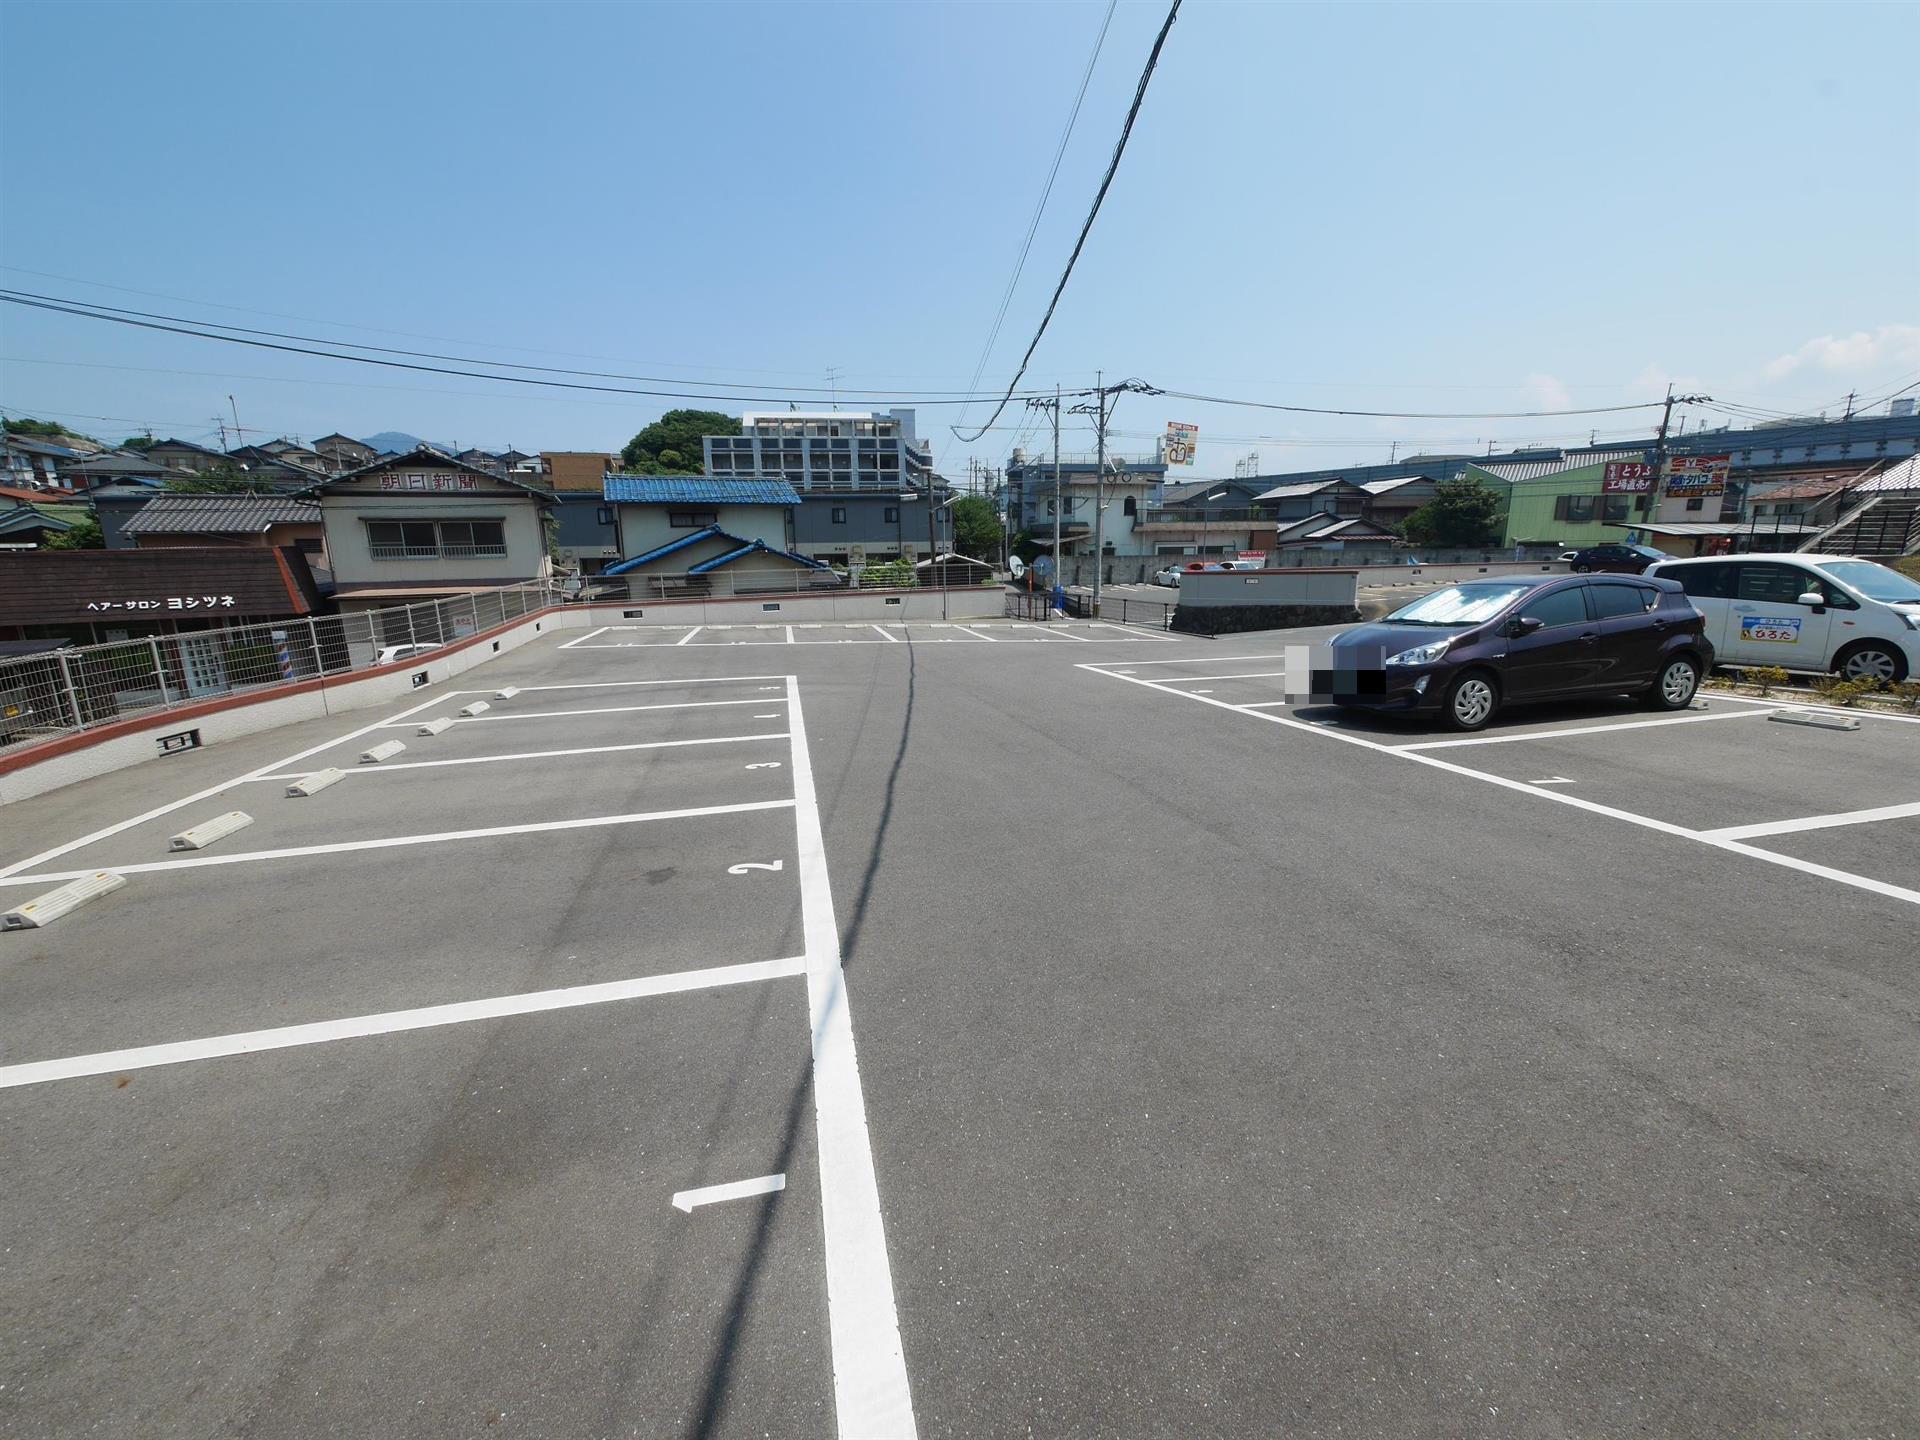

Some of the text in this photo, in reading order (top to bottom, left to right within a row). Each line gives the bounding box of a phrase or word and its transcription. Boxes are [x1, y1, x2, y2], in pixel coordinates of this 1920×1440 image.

[381, 473, 478, 490] 朝日新聞
[87, 595, 236, 611] ヘアーサロン ヨシツネ
[1755, 630, 1791, 640] ひろた
[745, 761, 782, 770] 3
[727, 859, 783, 875] 2
